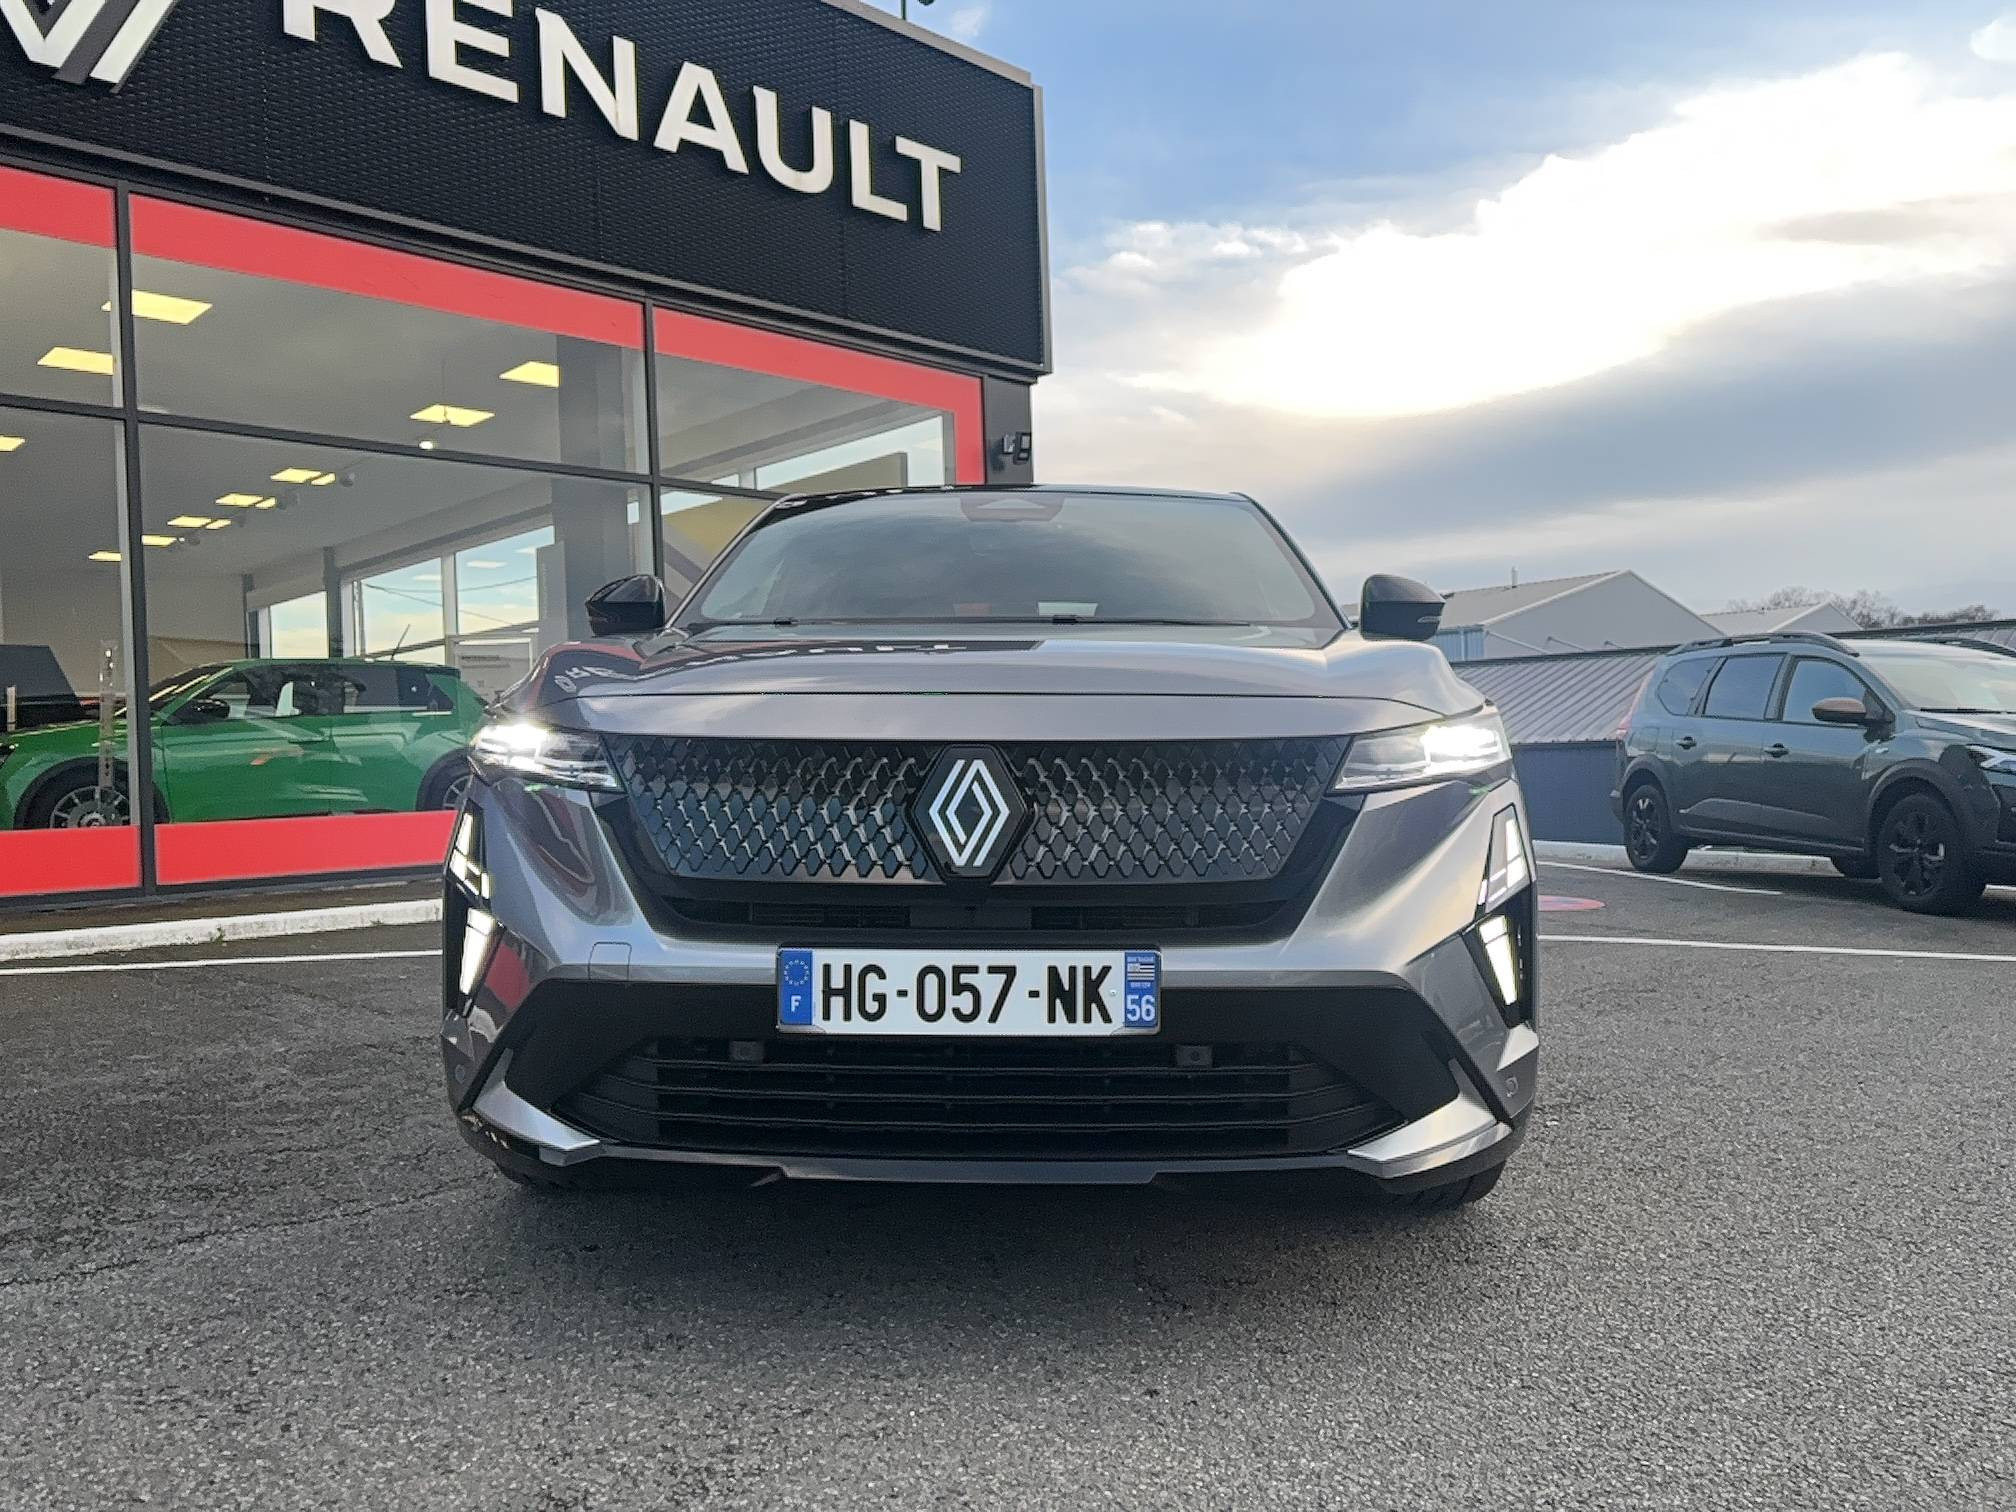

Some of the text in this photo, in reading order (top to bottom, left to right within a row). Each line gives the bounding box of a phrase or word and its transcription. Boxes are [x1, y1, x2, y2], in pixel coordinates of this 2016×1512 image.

[790, 995, 802, 1013] F
[822, 963, 1113, 1024] HG-057-NK
[1126, 994, 1156, 1022] 56
